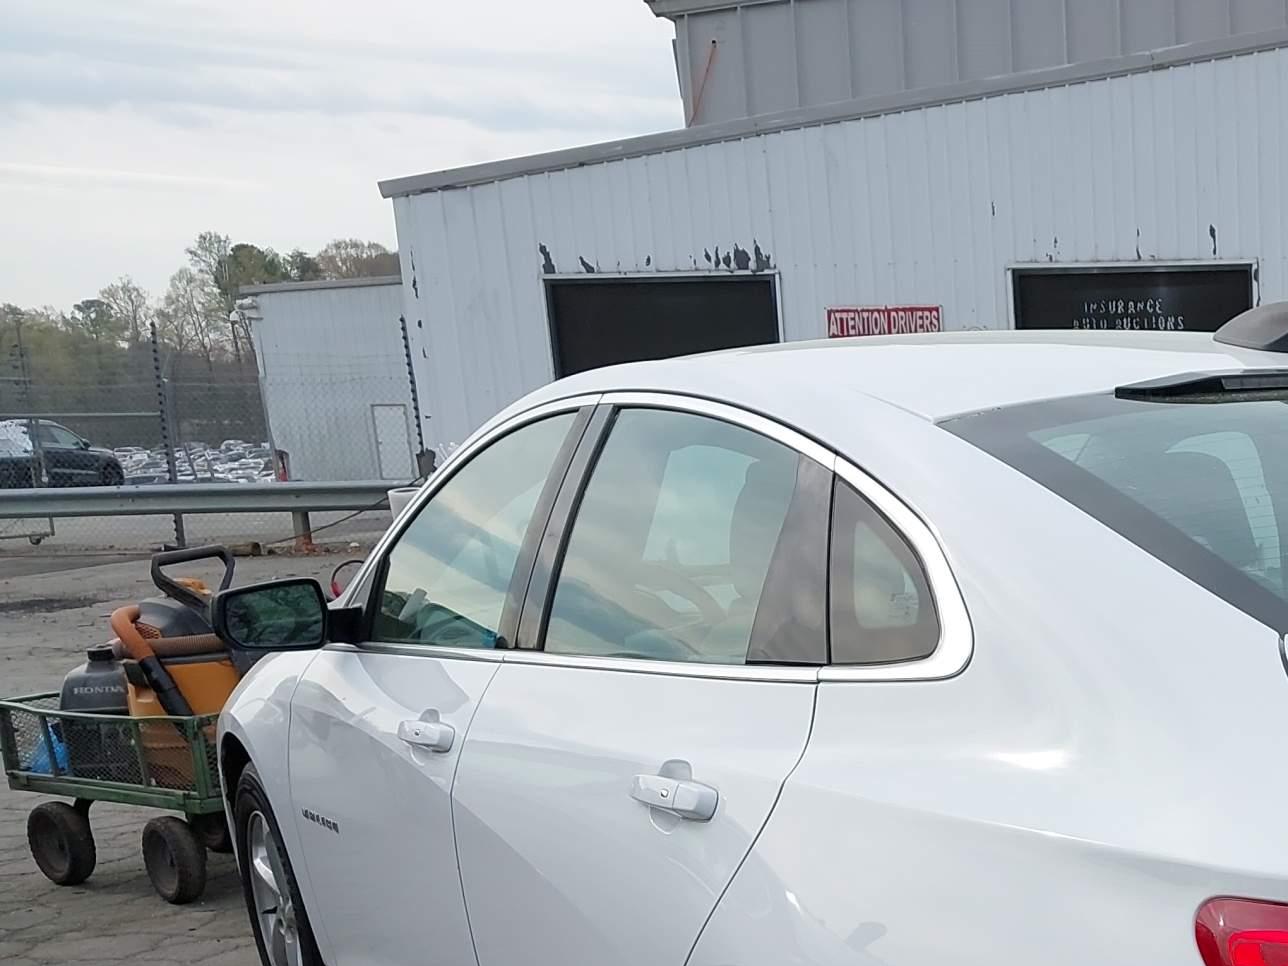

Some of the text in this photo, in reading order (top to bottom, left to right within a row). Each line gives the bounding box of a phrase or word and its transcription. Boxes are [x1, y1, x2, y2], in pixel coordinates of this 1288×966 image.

[1084, 298, 1163, 314] INSURANCE
[829, 310, 939, 336] ATTENTION DRIVERS
[73, 686, 125, 695] HONDA
